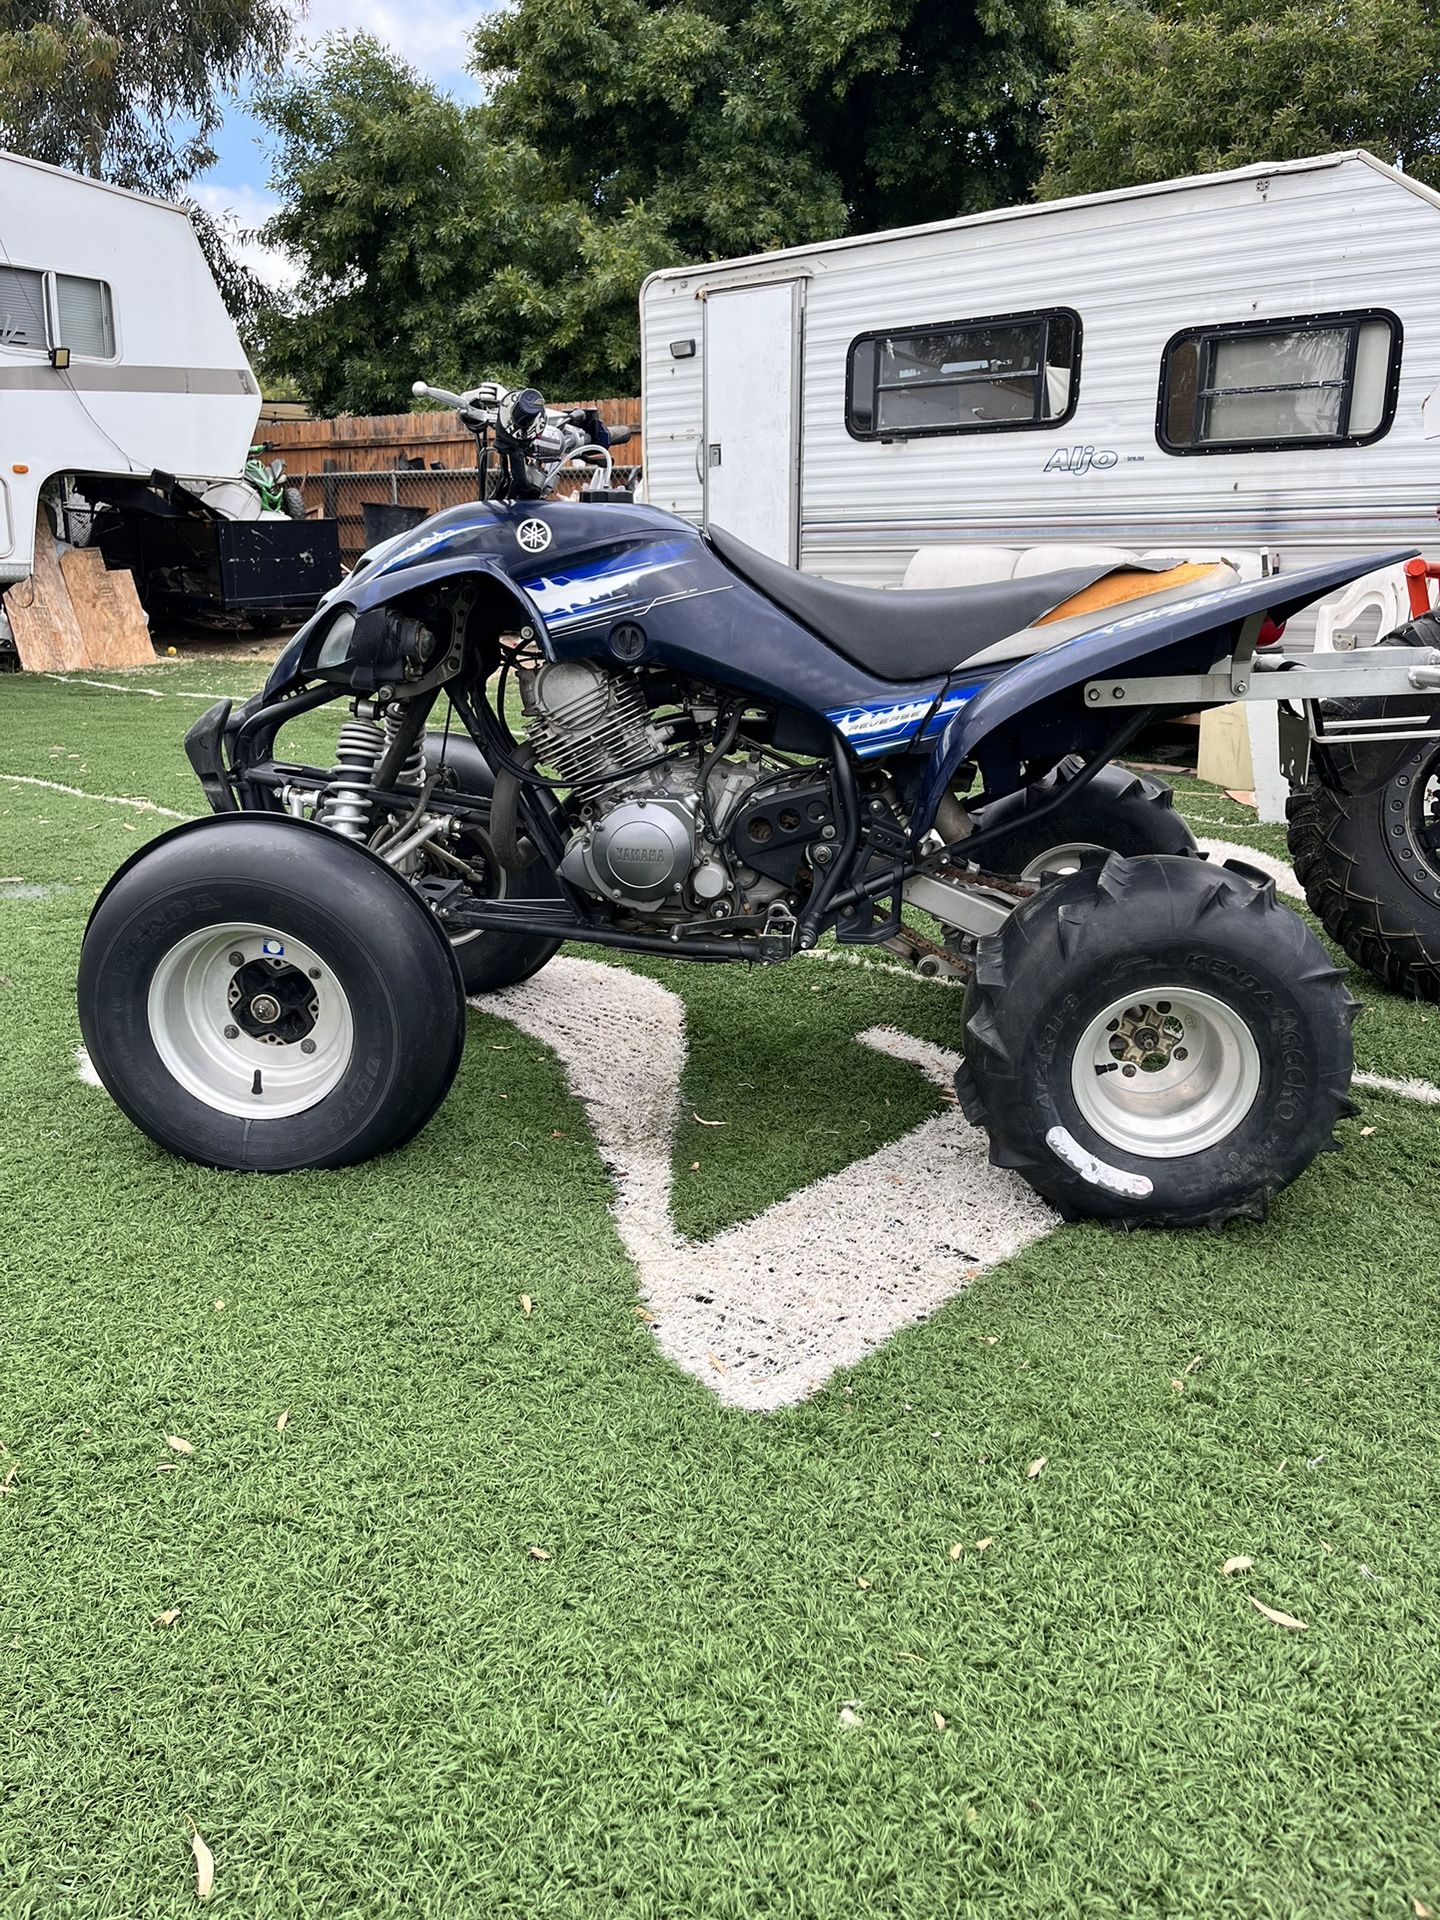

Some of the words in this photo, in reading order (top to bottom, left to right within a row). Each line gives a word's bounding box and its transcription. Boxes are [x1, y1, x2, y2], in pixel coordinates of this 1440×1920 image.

[1043, 446, 1118, 476] Aljo
[616, 847, 665, 863] YAMAHA
[1184, 953, 1276, 1007] KENDA
